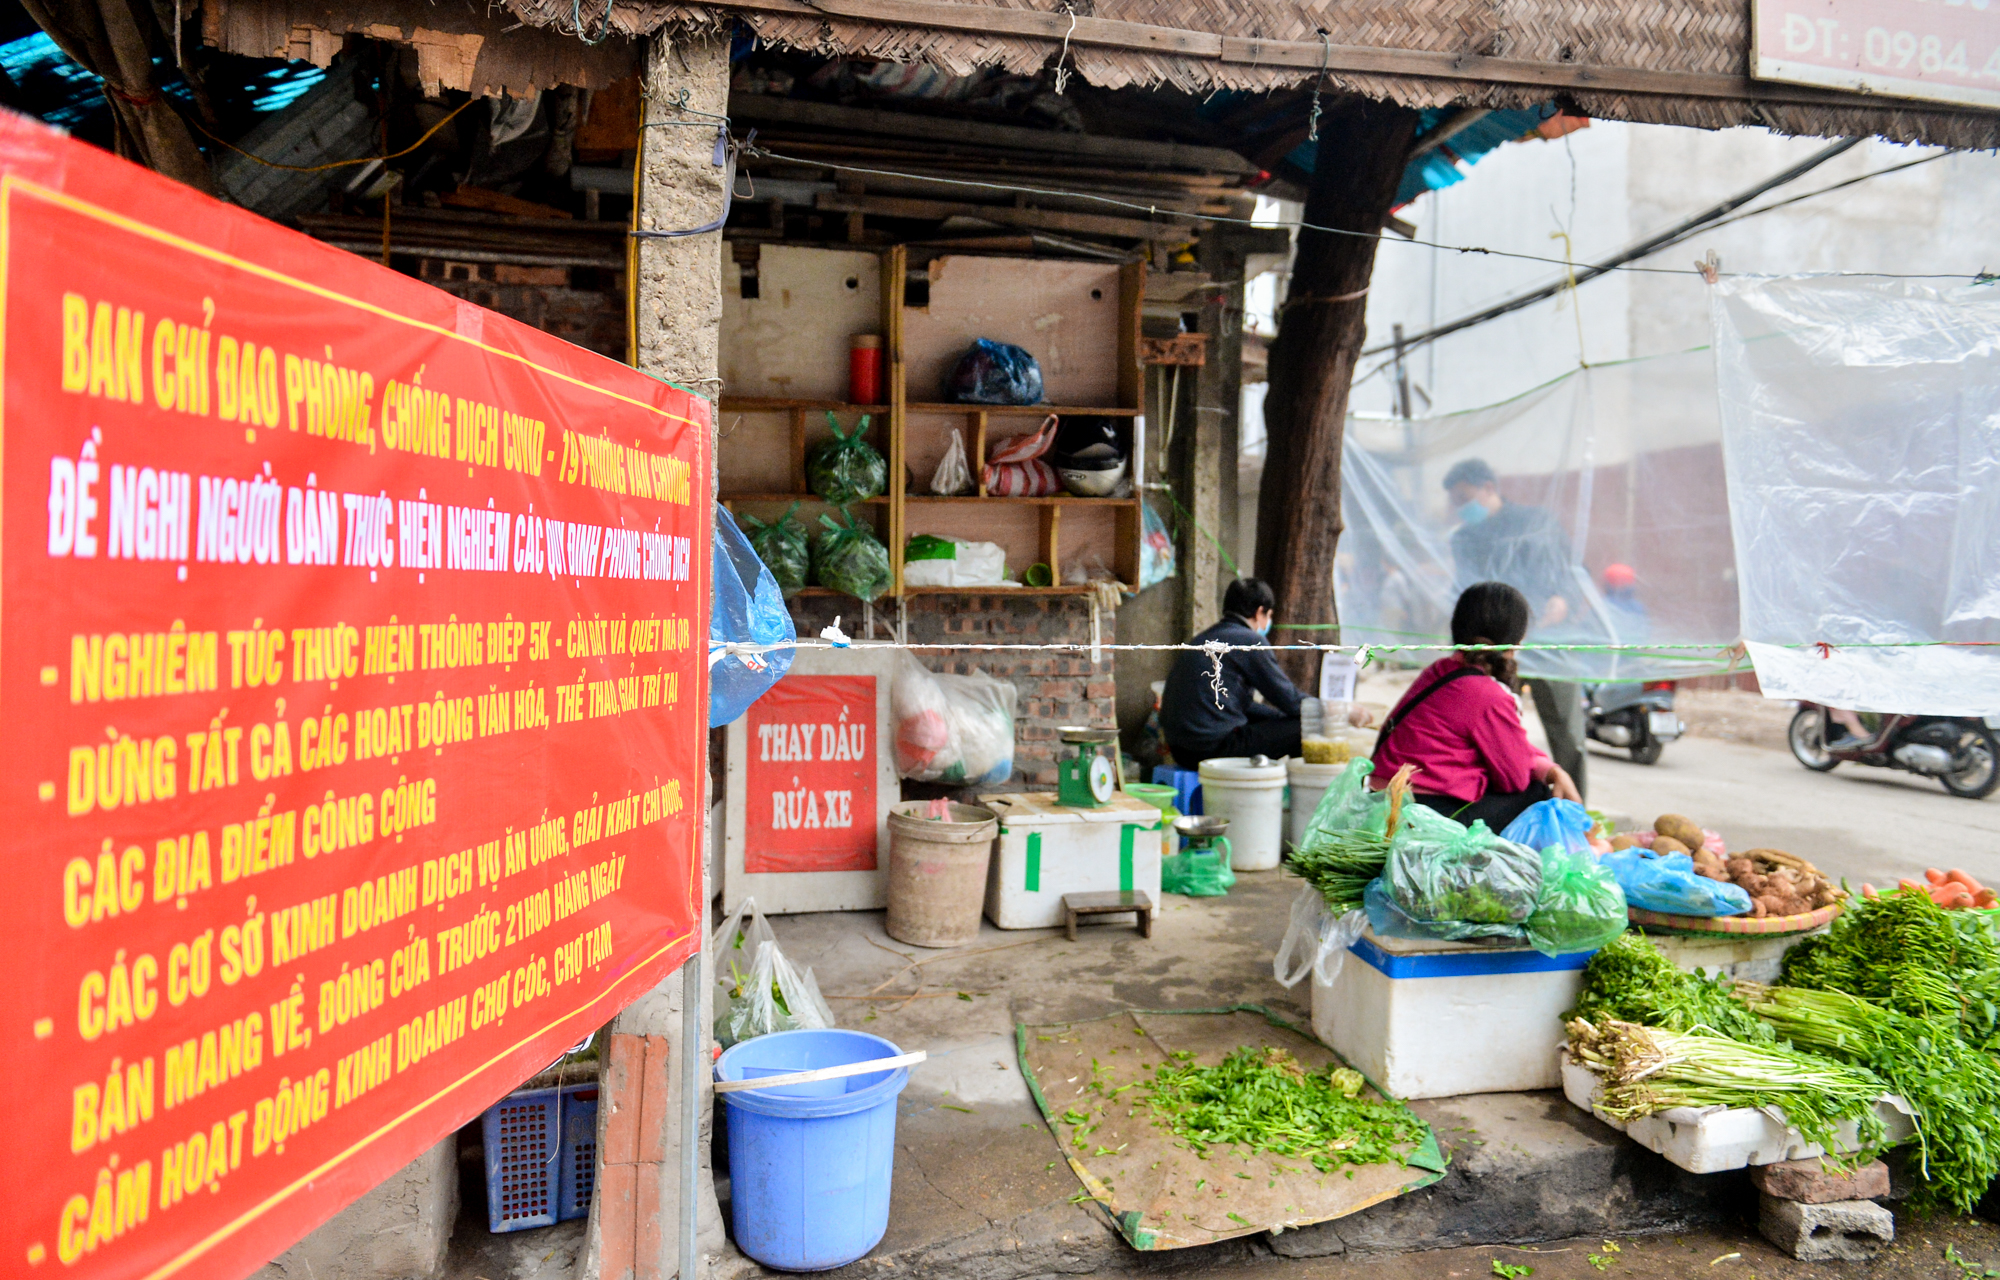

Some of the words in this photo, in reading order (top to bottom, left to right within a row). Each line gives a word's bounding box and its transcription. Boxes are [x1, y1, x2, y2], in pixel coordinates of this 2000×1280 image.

[1780, 12, 1849, 61] ĐT:
[62, 290, 145, 405] BAN
[152, 296, 215, 417] CHỈ
[217, 335, 280, 444] ĐẠO
[285, 344, 376, 456] PHÒNG,
[382, 364, 451, 459] CHỐNG
[456, 398, 498, 478] DỊCH
[503, 410, 545, 477] COVID
[559, 428, 579, 484] 19
[578, 426, 627, 494] PHƯỜNG
[626, 438, 652, 499] VĂN
[650, 453, 691, 507] CHƯƠNG
[48, 425, 101, 558] ĐỀ
[108, 464, 191, 582] NGHỊ
[196, 461, 282, 564] NGƯỜI
[286, 472, 339, 566] DÂN
[343, 489, 394, 583] THỰC
[399, 487, 442, 584] HIỆN
[447, 497, 511, 572] NGHIÊM
[513, 502, 544, 573] CÁC
[546, 518, 567, 581] QUY
[567, 522, 602, 589] ĐỊNH
[599, 516, 641, 580] PHÒNG
[643, 516, 672, 582] CHỐNG
[672, 535, 691, 592] DỊCH
[70, 618, 218, 705] NGHIÊM
[226, 617, 285, 689] TÚC
[291, 621, 360, 691] THỰC
[363, 614, 415, 684] HIỆN
[419, 613, 484, 670] THÔNG
[486, 613, 525, 672] ĐIỆP
[529, 621, 552, 661] 5K
[567, 612, 590, 659] CÀI
[588, 612, 608, 664] ĐẶT
[610, 612, 627, 655] VÀ
[629, 612, 661, 657] QUÉT
[677, 618, 690, 653] QR
[758, 723, 817, 762] THAY
[820, 704, 866, 761] DẦU
[67, 724, 178, 818] DỪNG
[186, 707, 244, 793] TẤT
[250, 697, 293, 781] CẢ
[299, 704, 349, 772] CÁC
[355, 703, 413, 766] HOẠT
[417, 691, 474, 756] ĐỘNG
[478, 684, 510, 738] VĂN
[514, 680, 550, 731] HÓA,
[556, 667, 585, 724] THỂ
[618, 662, 640, 712] GIẢI
[642, 666, 662, 708] TRÍ
[663, 671, 679, 711] TẠI
[772, 775, 820, 830] RỬA
[823, 790, 852, 828] XE
[63, 837, 146, 929] CÁC
[153, 830, 213, 911] ĐỊA
[220, 793, 297, 884] ĐIỂM
[301, 789, 374, 860] CÔNG
[380, 775, 437, 844] CỘNG
[77, 948, 158, 1042] CÁC
[167, 928, 214, 1007] CƠ
[219, 894, 265, 986] SỞ
[271, 893, 338, 968] KINH
[341, 865, 418, 940] DOANH
[422, 848, 472, 913] DỊCH
[477, 840, 500, 892] VỤ
[504, 827, 527, 878] ĂN
[530, 807, 569, 867] UỐNG,
[572, 791, 604, 849] GIẢI
[605, 789, 640, 838] KHÁT
[642, 775, 660, 826] CHỈ
[661, 778, 683, 820] ĐƯỢC
[71, 1056, 155, 1155] BÁN
[164, 1011, 263, 1110] MANG
[270, 972, 312, 1058] VỀ,
[318, 959, 385, 1034] ĐÓNG
[389, 923, 430, 999] CỬA
[436, 902, 501, 976] TRƯỚC
[504, 887, 551, 948] 21H00
[554, 870, 590, 922] HÀNG
[590, 851, 626, 902] NGÀY
[57, 1153, 152, 1266] CẤM
[159, 1109, 248, 1210] HOẠT
[252, 1067, 331, 1157] ĐỘNG
[334, 1033, 392, 1110] KINH
[396, 993, 468, 1073] DOANH
[471, 970, 510, 1026] CHỢ
[512, 952, 551, 1009] CÓC,
[553, 934, 584, 986] CHỢ
[585, 920, 613, 972] TẠM
